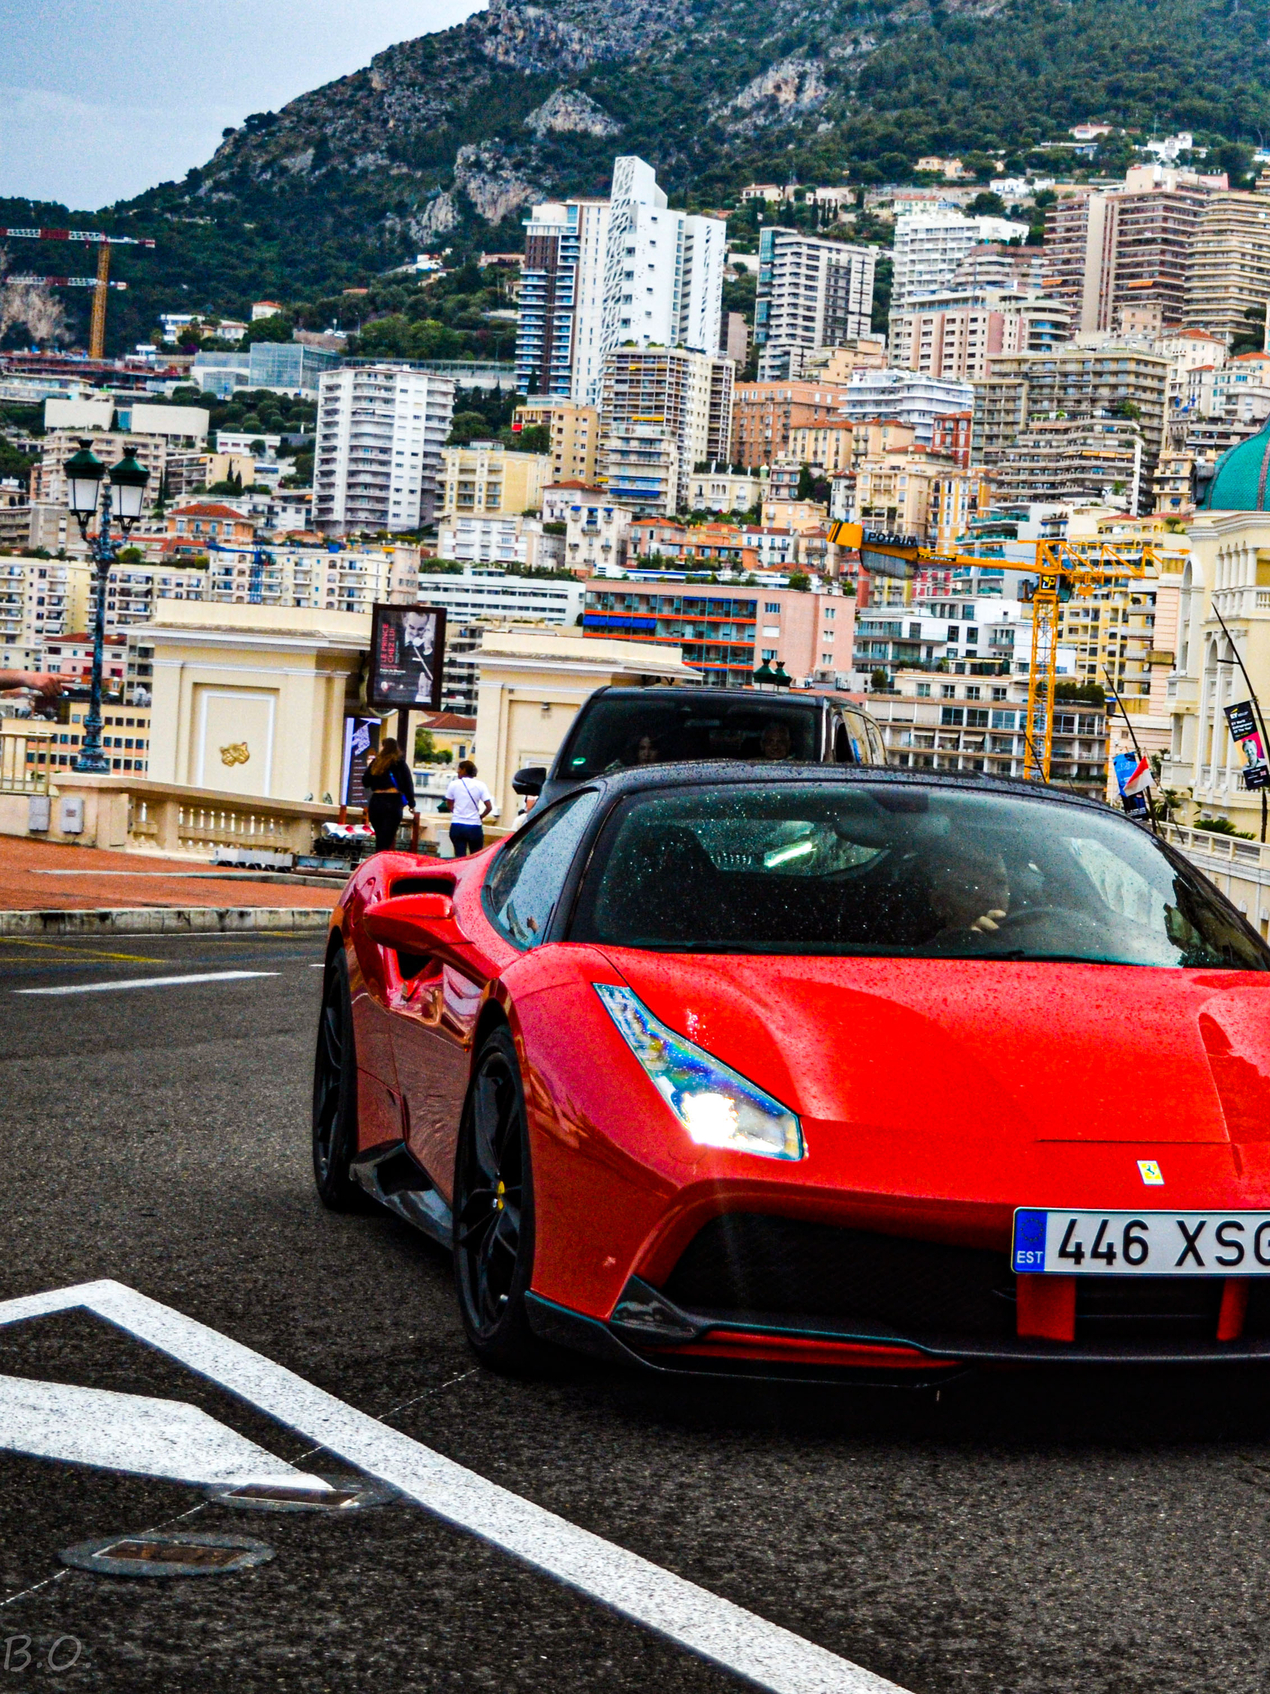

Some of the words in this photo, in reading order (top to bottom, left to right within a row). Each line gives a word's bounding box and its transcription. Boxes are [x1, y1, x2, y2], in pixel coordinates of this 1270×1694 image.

[868, 531, 918, 547] POTAIN
[1058, 1218, 1149, 1267] 446
[1016, 1250, 1044, 1265] EST
